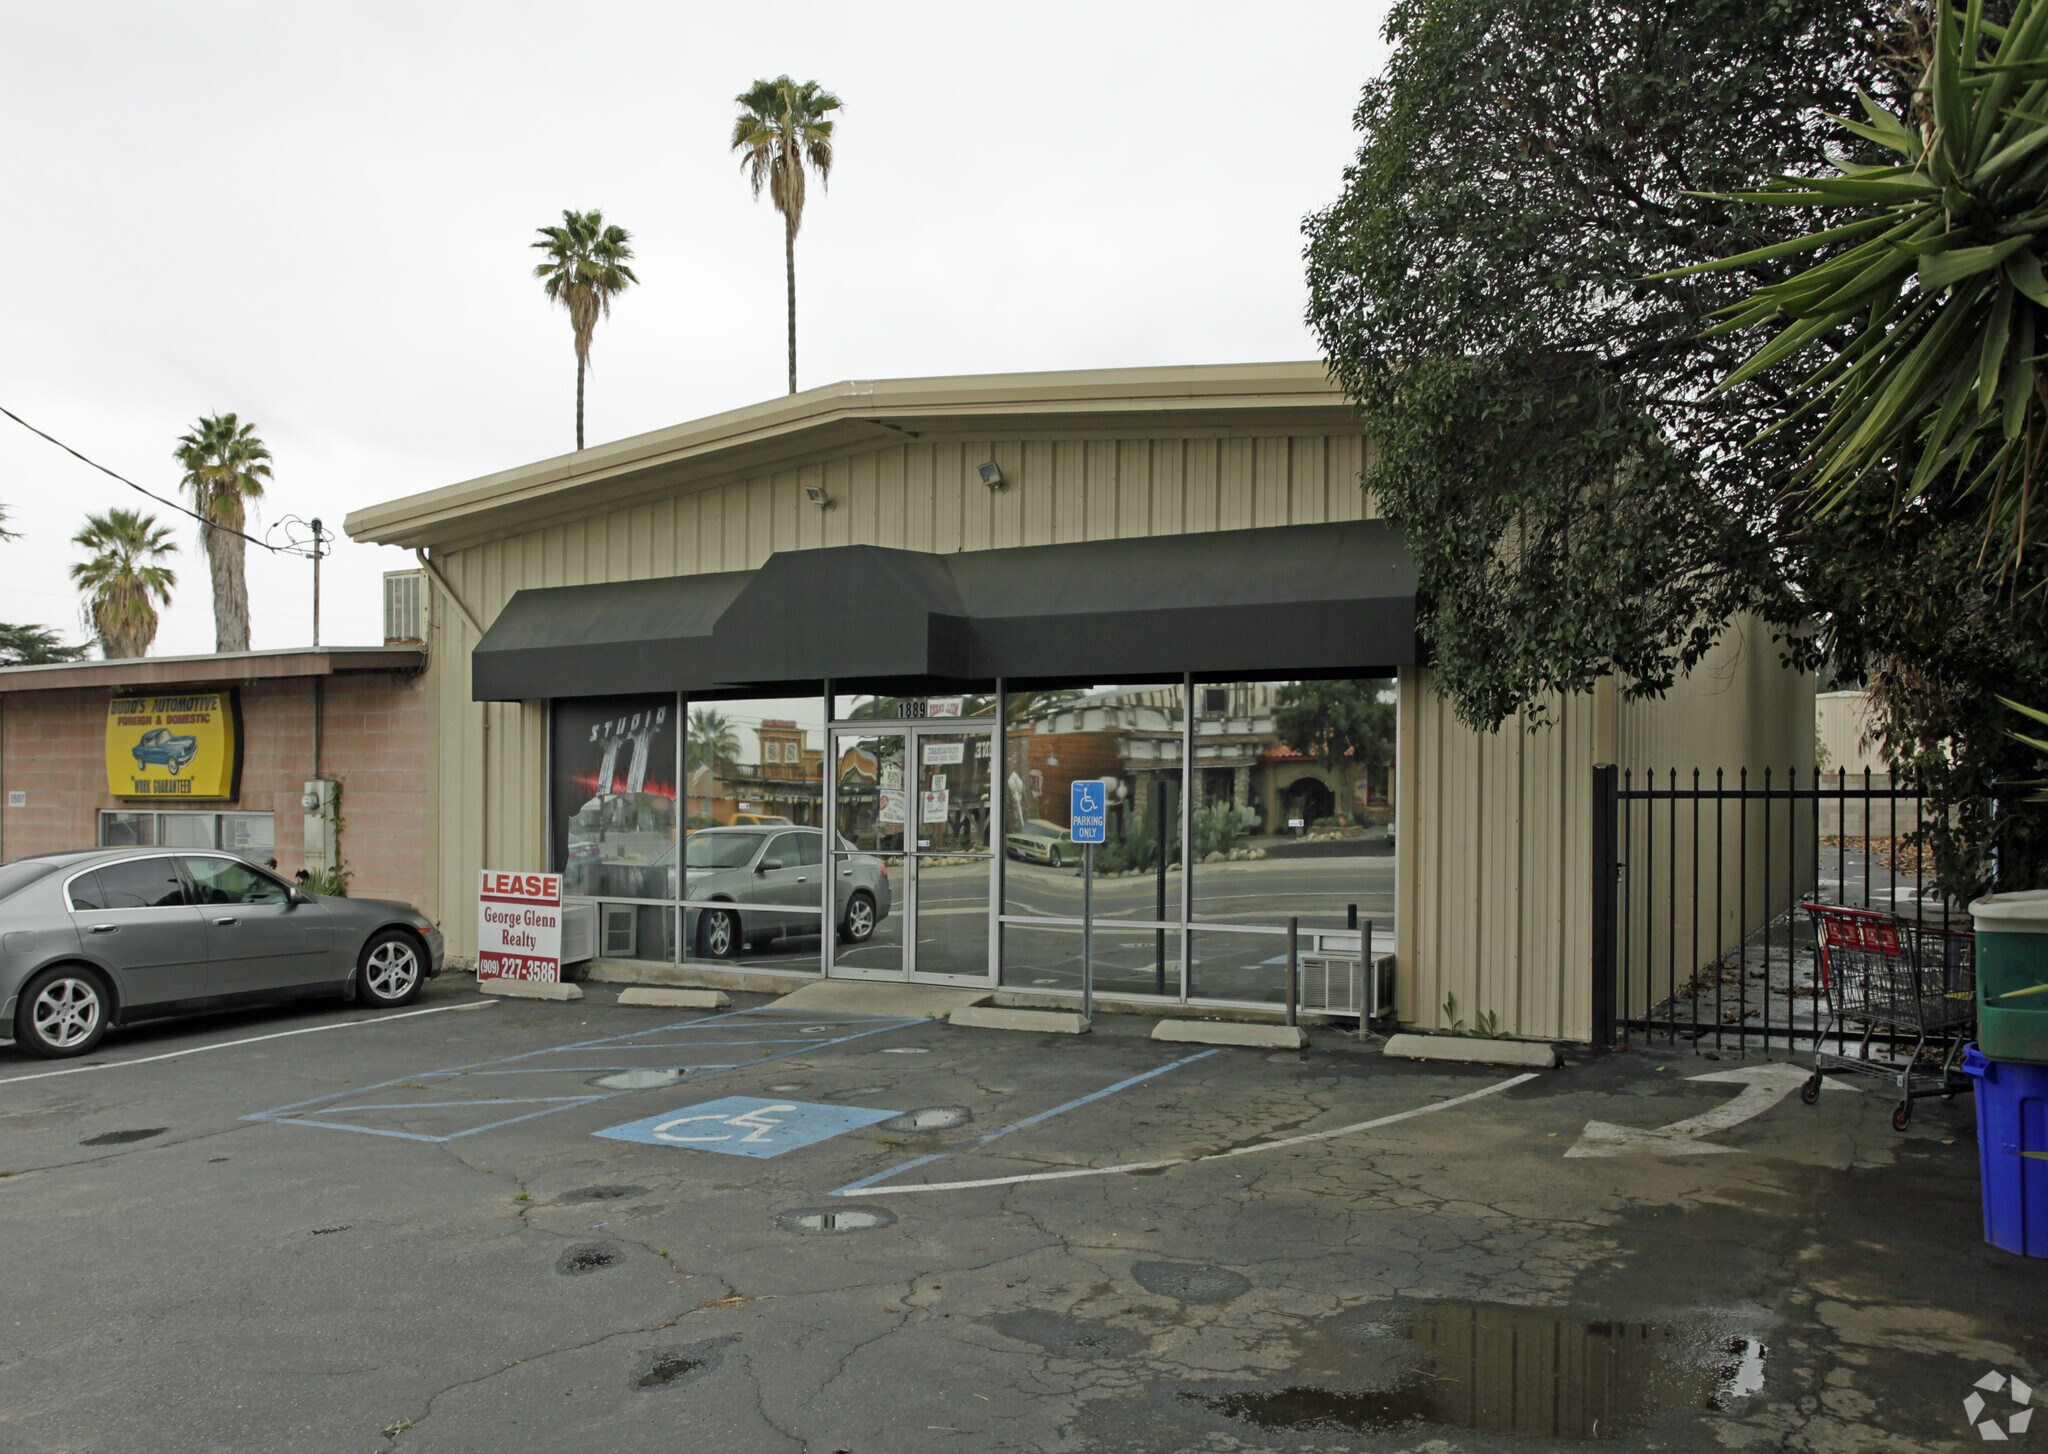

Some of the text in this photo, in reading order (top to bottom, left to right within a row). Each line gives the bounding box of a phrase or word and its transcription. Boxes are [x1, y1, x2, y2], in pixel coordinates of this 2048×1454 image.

[151, 695, 218, 713] AUTOMOTIVE
[899, 702, 926, 717] 1889
[117, 713, 211, 726] FOREIGN & DOMESTIC
[589, 706, 667, 743] STUDIO
[1073, 816, 1103, 826] PARKING
[1079, 827, 1097, 838] ONLY
[482, 873, 558, 897] LEASE
[484, 906, 556, 929] George Glenn
[502, 929, 537, 952] Realty
[480, 957, 556, 982] (909) 227-3586
